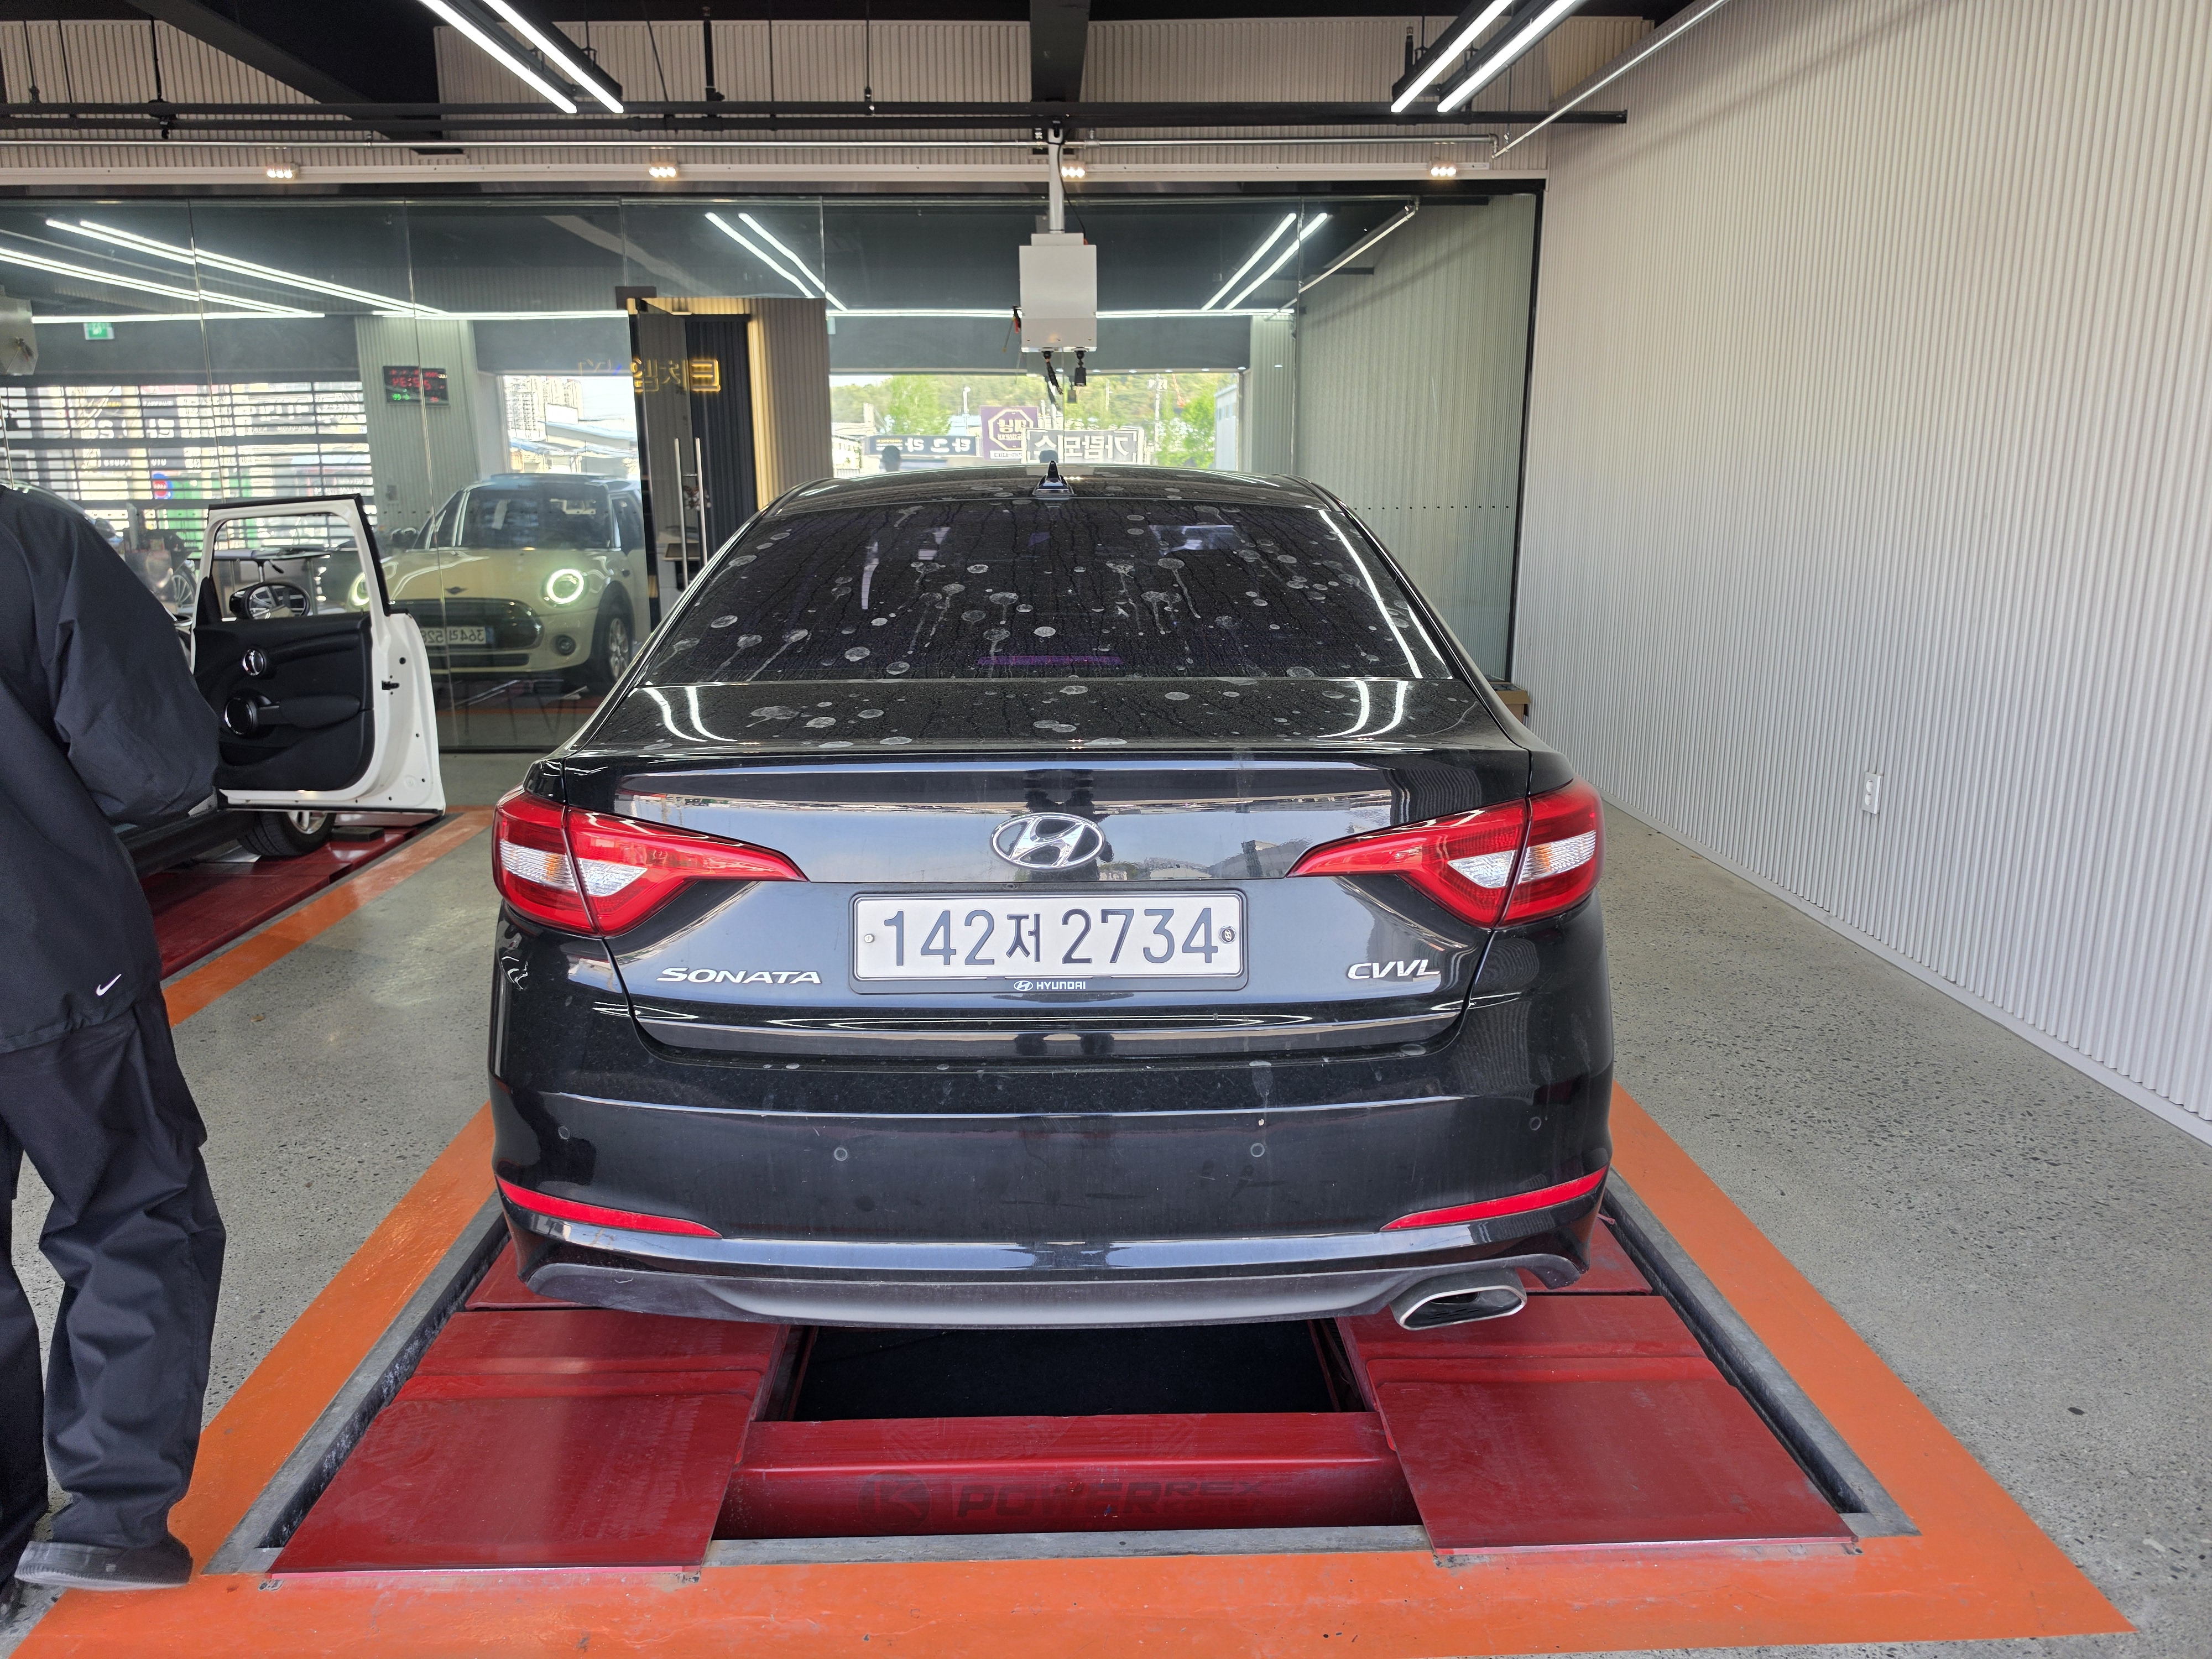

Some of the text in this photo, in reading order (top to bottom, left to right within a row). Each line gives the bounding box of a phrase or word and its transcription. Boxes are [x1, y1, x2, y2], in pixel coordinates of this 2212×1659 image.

[884, 908, 1218, 966] 142저 2734
[656, 967, 822, 984] SONATA
[1347, 959, 1440, 979] CVVL
[1036, 980, 1087, 990] HYUNDAI
